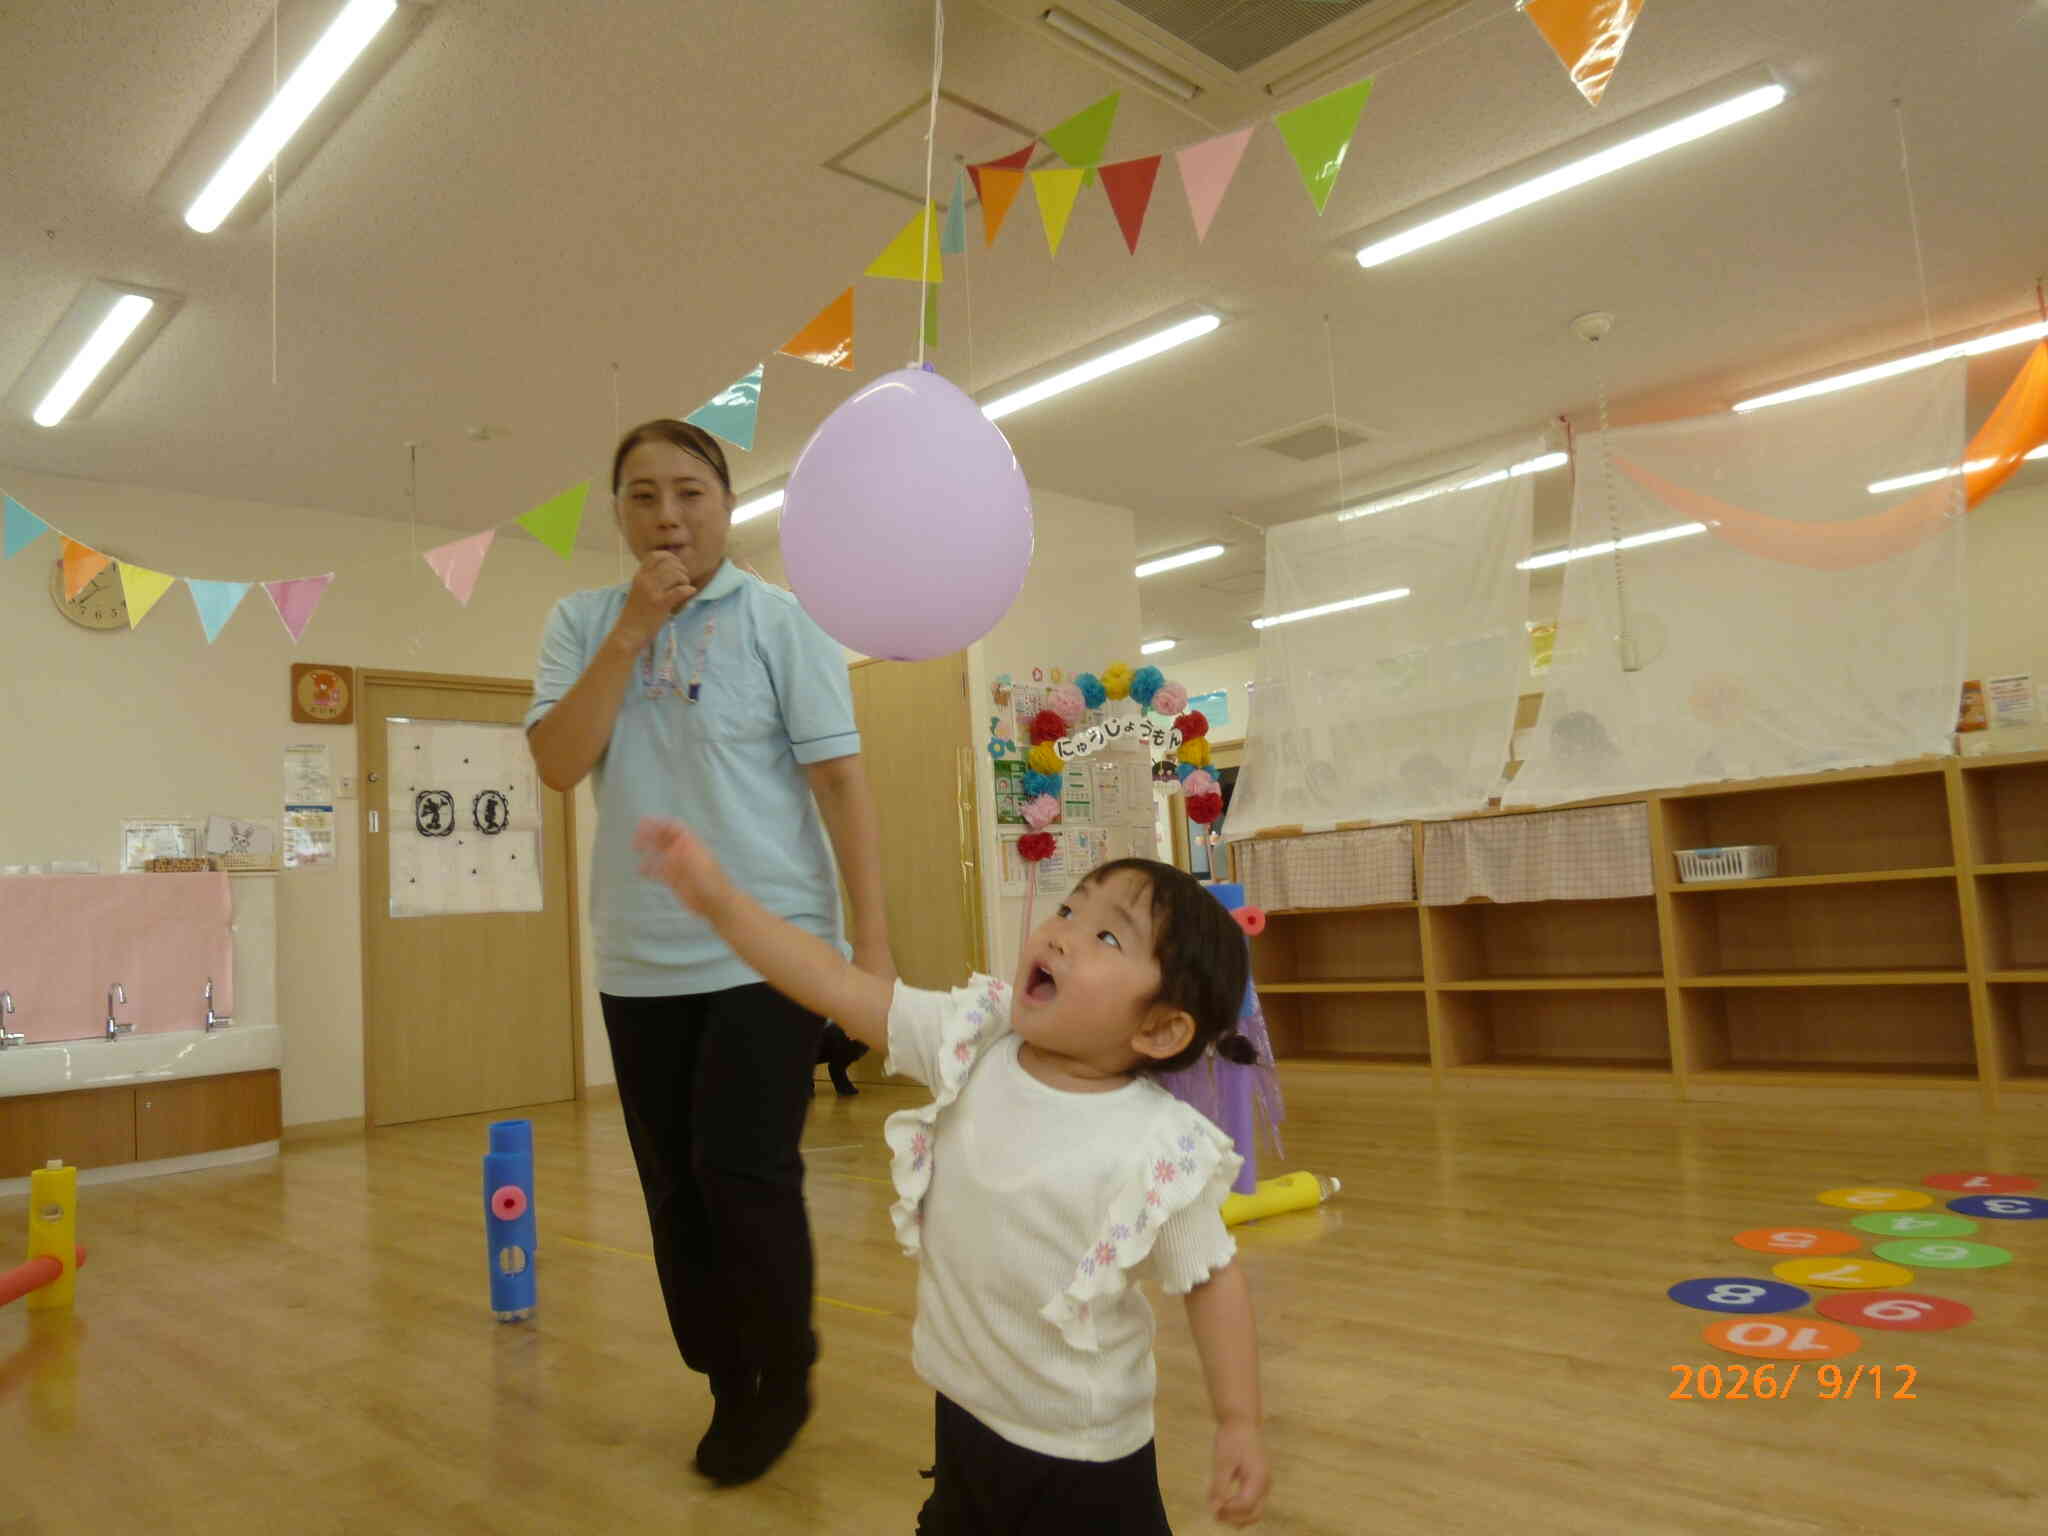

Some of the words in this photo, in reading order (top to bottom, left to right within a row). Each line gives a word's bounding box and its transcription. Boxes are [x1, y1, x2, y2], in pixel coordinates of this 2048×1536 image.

[1057, 719, 1181, 757] にゅうじょうもん
[1963, 1176, 1991, 1188] 1
[1847, 1191, 1897, 1205] 2
[1983, 1199, 2032, 1214] 3
[1891, 1215, 1939, 1231] 4
[1767, 1231, 1817, 1249] 5
[1911, 1245, 1969, 1261] 6
[1807, 1264, 1863, 1283] 7
[1706, 1283, 1767, 1305] 8
[1863, 1300, 1934, 1321] 9
[1726, 1321, 1831, 1352] 10
